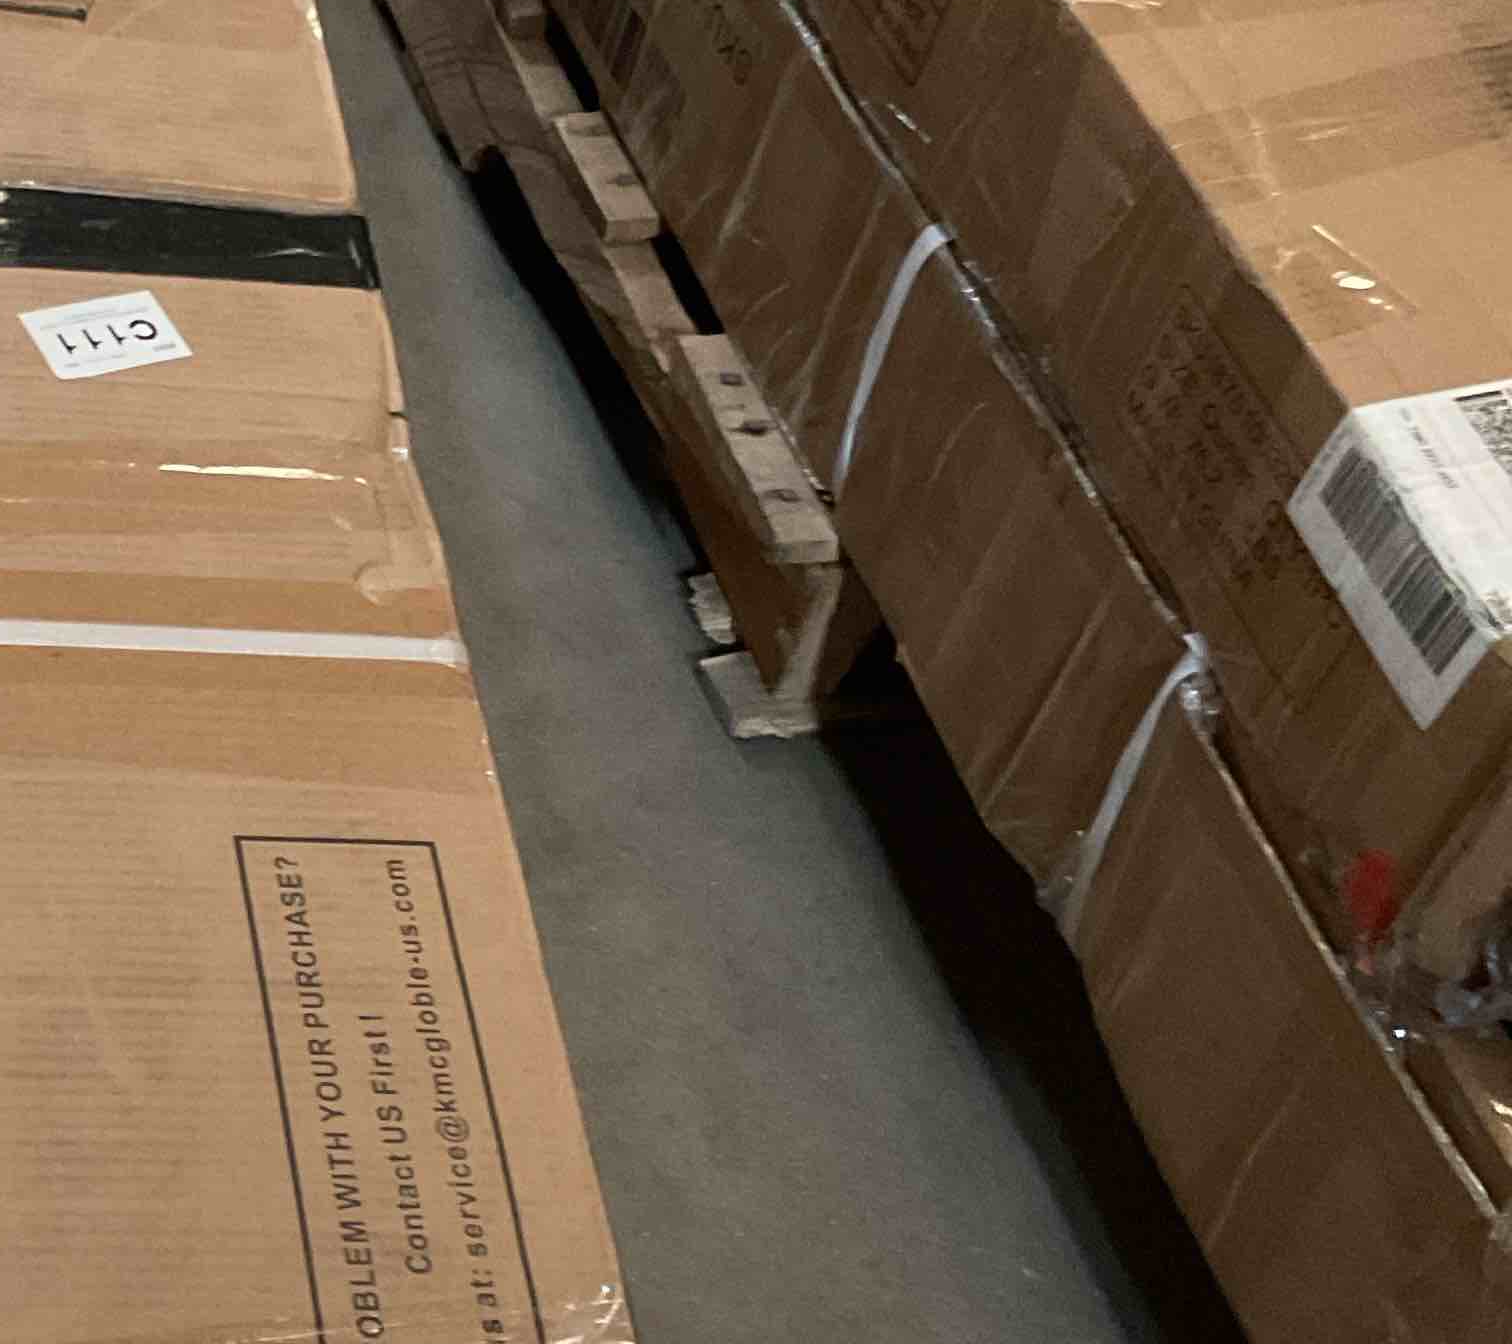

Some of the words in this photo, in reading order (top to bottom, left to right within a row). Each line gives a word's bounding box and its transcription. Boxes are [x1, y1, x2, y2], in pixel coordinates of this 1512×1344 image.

[57, 319, 158, 354] C111
[274, 855, 329, 1029] PURCHASE?
[308, 1038, 346, 1122] YOUR
[377, 1105, 408, 1144] US
[324, 1131, 363, 1210] WITH
[388, 1154, 432, 1274] Contact
[470, 1269, 498, 1307] at:
